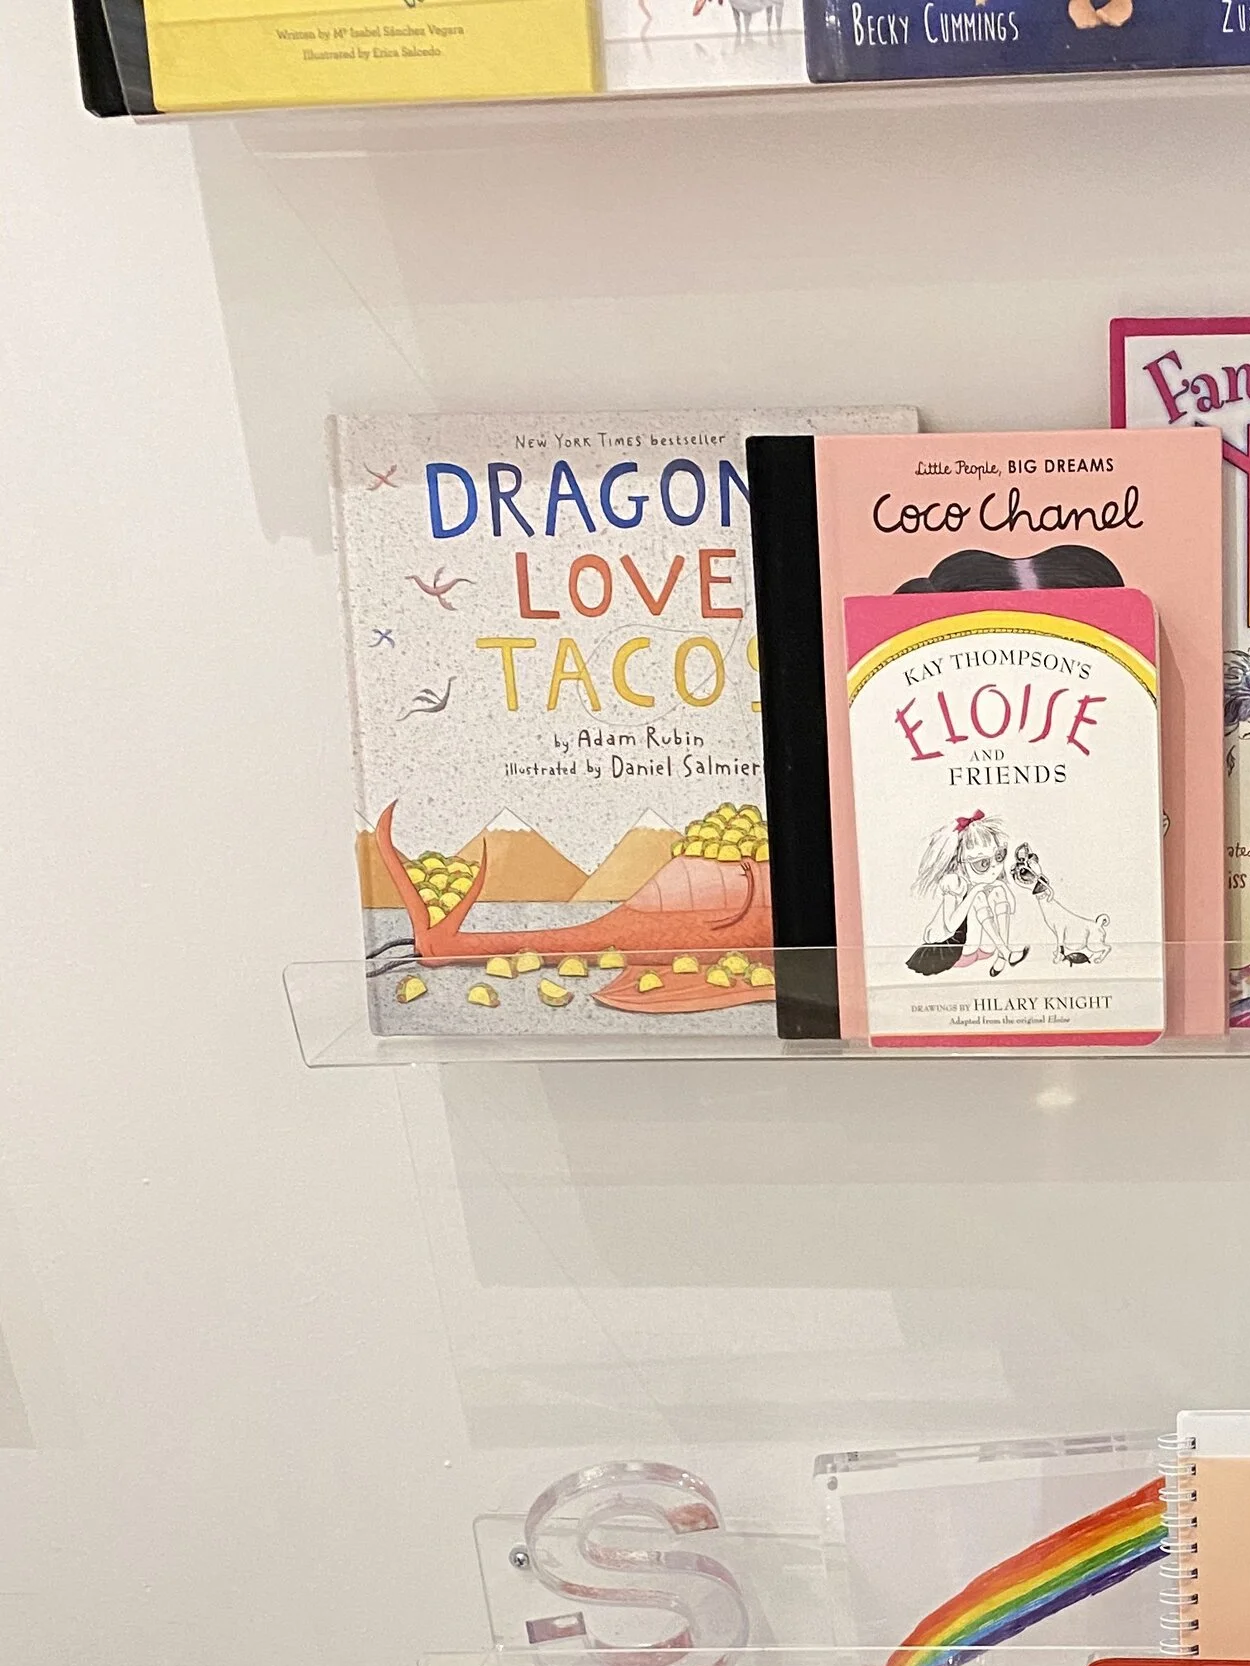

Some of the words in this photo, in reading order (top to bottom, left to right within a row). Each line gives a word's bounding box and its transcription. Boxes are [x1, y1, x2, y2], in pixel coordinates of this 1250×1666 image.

[276, 28, 316, 40] Written
[318, 27, 330, 41] by
[350, 26, 381, 38] Isabel
[427, 23, 464, 37] Vegara
[853, 2, 909, 45] BECKY
[924, 2, 1019, 43] CUMMINGS
[303, 48, 355, 61] Illustrated
[357, 47, 369, 60] by
[650, 433, 726, 447] bestseller
[915, 461, 952, 475] Little
[955, 460, 1001, 480] People,
[1008, 460, 1037, 473] BIG
[1044, 458, 1114, 473] DREAMS
[426, 459, 751, 539] DRAGON
[873, 493, 971, 533] Coco
[979, 486, 1144, 532] Chanel
[515, 548, 743, 619] LOVE
[475, 636, 761, 713] TACO
[903, 657, 945, 686] KAY
[949, 649, 1092, 680] THOMPSON'S
[894, 683, 1107, 761] ELOISE
[554, 734, 569, 753] by
[578, 729, 636, 747] Adam
[647, 726, 704, 749] Rubin
[505, 761, 576, 776] illustrated
[586, 759, 601, 778] by
[612, 755, 671, 778] Daniel
[684, 754, 760, 777] Salmier
[970, 749, 1004, 762] AND
[948, 764, 1067, 786] FRIENDS
[911, 1004, 958, 1013] DRAWINGS
[959, 1003, 970, 1012] BY
[973, 997, 1038, 1011] HILARY
[1043, 995, 1112, 1011] KNIGHT
[950, 1016, 980, 1027] Adapted
[982, 1016, 1001, 1025] from
[1002, 1016, 1015, 1025] the
[1016, 1015, 1045, 1026] original
